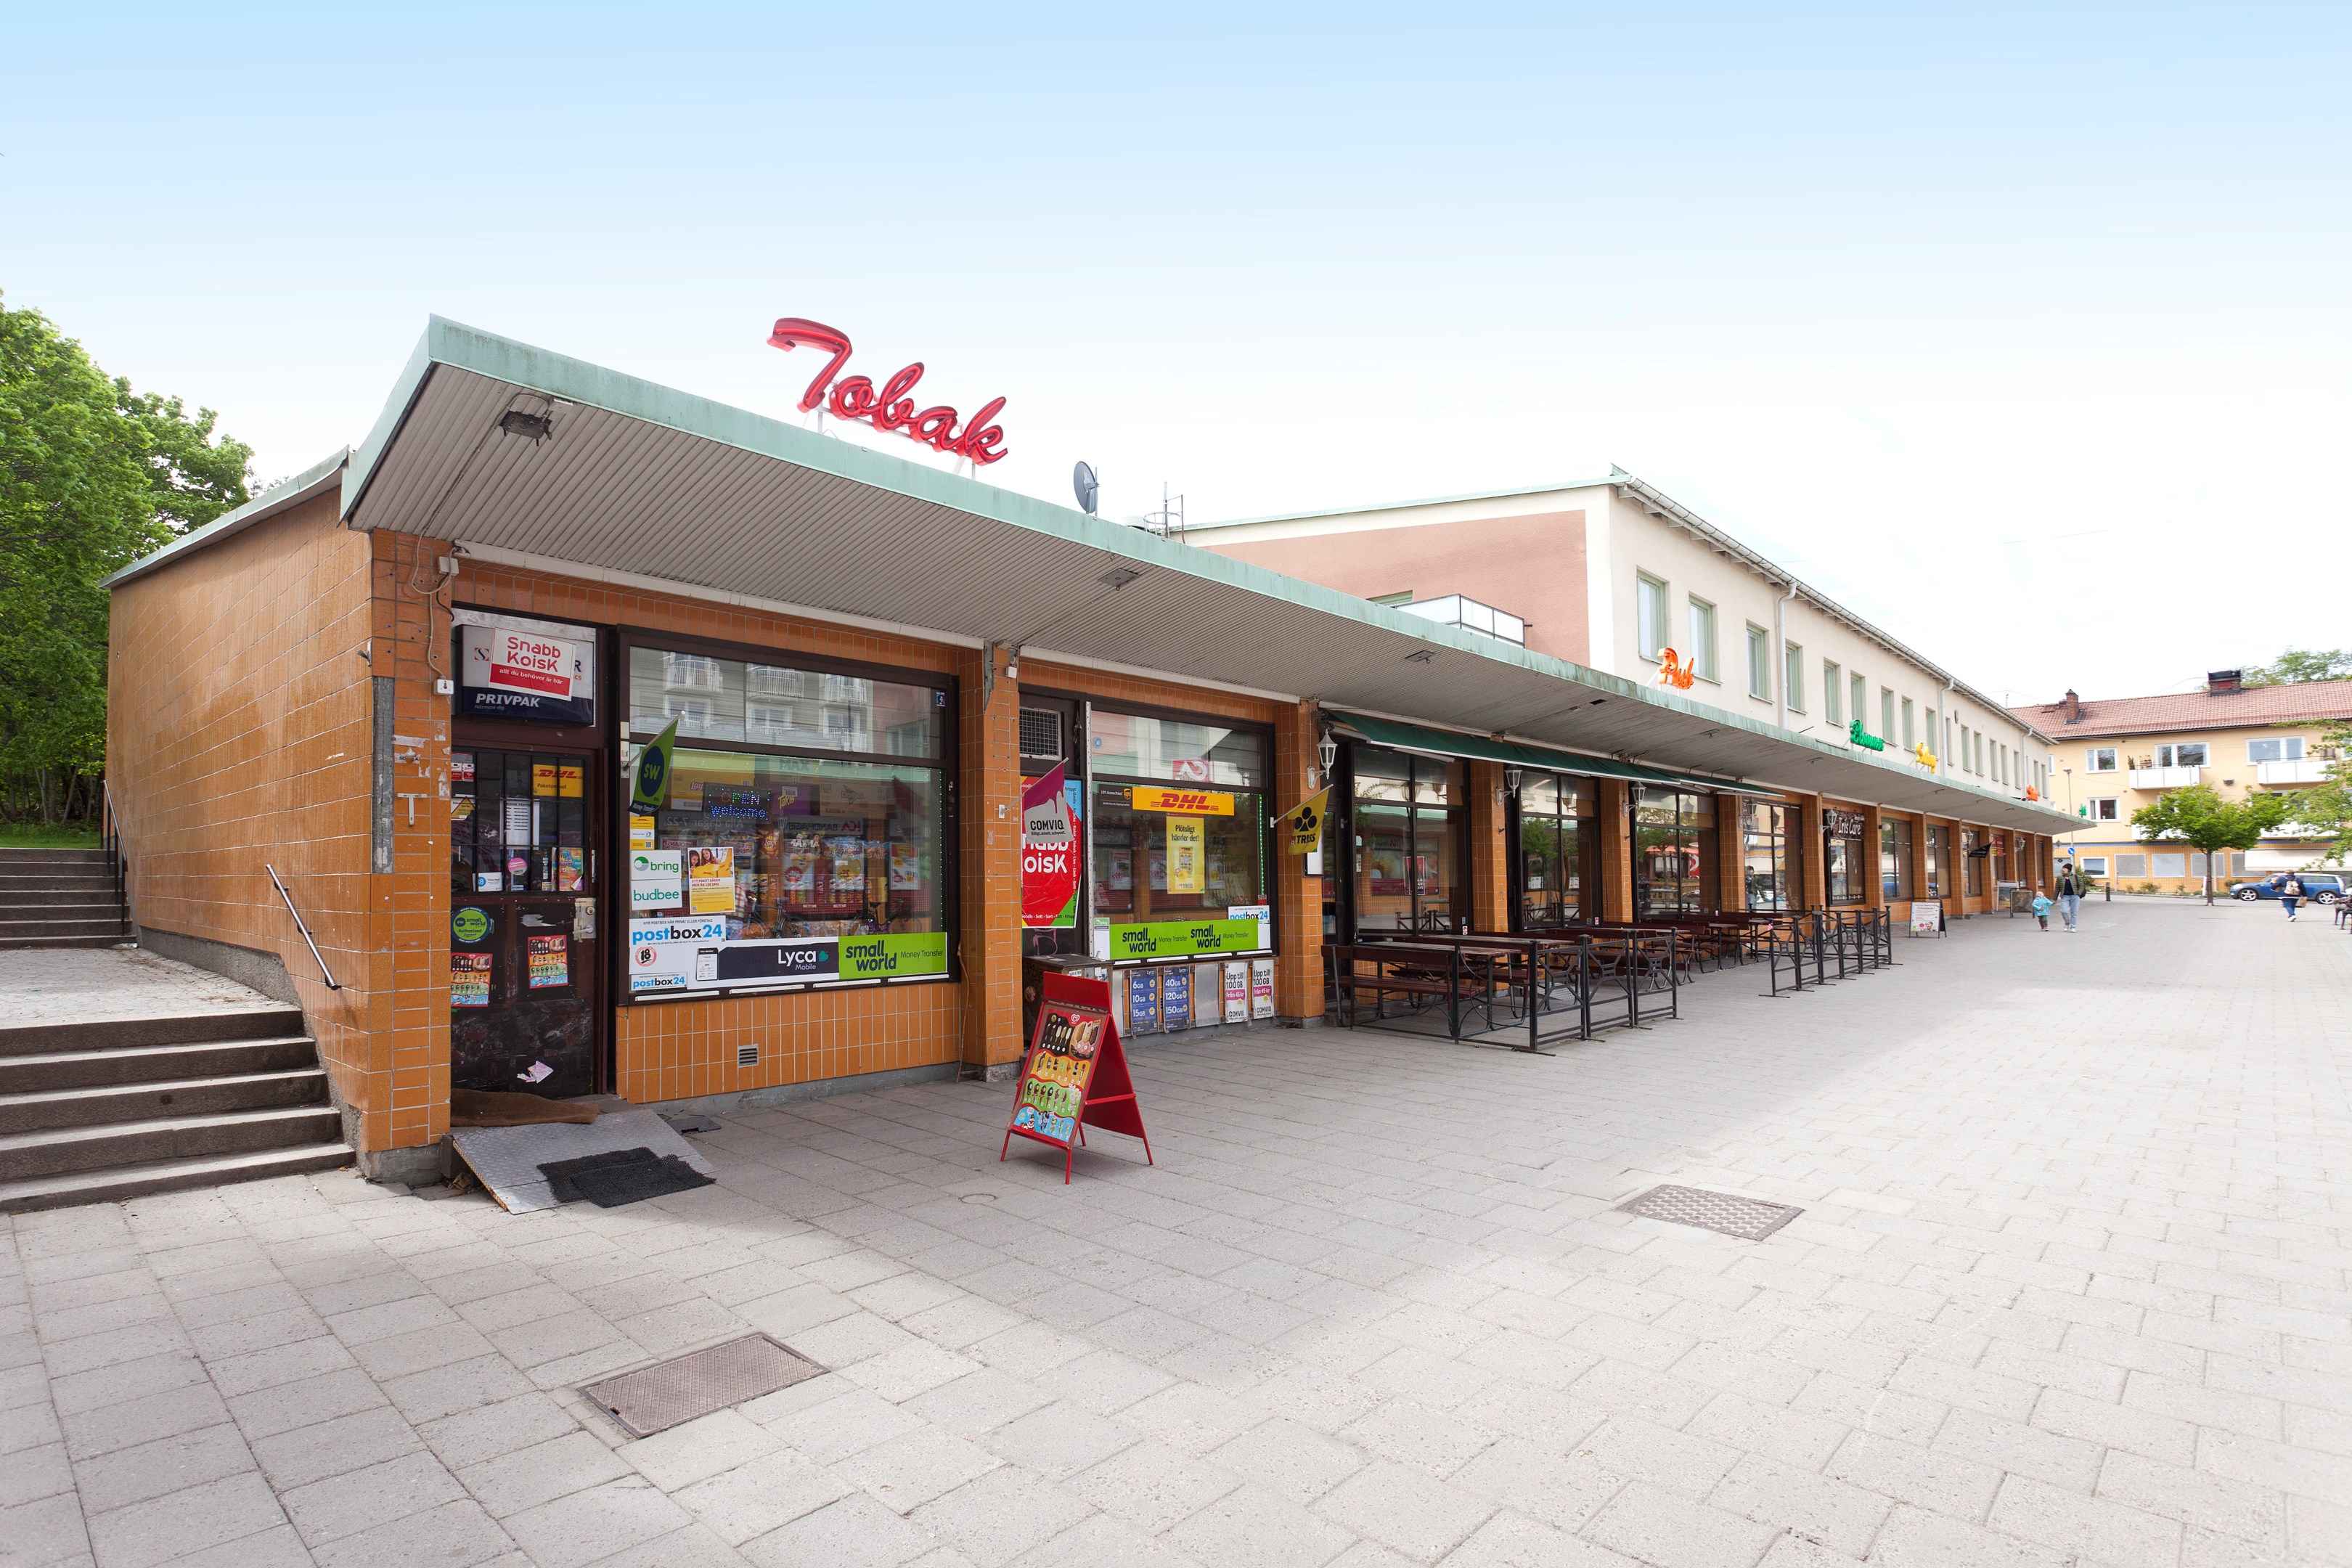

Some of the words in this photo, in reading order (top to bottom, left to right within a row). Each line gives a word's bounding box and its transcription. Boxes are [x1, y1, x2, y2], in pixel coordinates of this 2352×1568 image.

[767, 317, 1008, 467] Tobak
[507, 637, 561, 658] Snabb
[520, 671, 544, 681] behöver
[1657, 647, 1694, 690] Pub
[475, 693, 541, 708] PRIVPAK
[539, 769, 579, 779] DHL
[644, 764, 660, 780] SW
[722, 792, 760, 805] OPEN
[1160, 793, 1210, 810] DHL
[711, 804, 765, 818] welcome
[1030, 820, 1065, 831] COMVIQ
[1175, 825, 1195, 834] Plötsligt
[1849, 819, 1861, 835] Care
[1297, 833, 1316, 844] TRISS
[650, 861, 679, 873] bring
[1021, 852, 1067, 874] oisK
[633, 889, 679, 901] budbee
[632, 924, 722, 945] postbox24
[1122, 928, 1148, 942] small
[1191, 924, 1213, 938] small
[1129, 938, 1156, 953] world
[1197, 934, 1221, 949] world
[641, 949, 651, 961] 18
[846, 940, 885, 959] small
[901, 951, 920, 959] Money
[921, 949, 944, 957] Transfer
[778, 949, 817, 967] Lyca
[856, 953, 897, 972] world
[633, 976, 685, 989] postbox24
